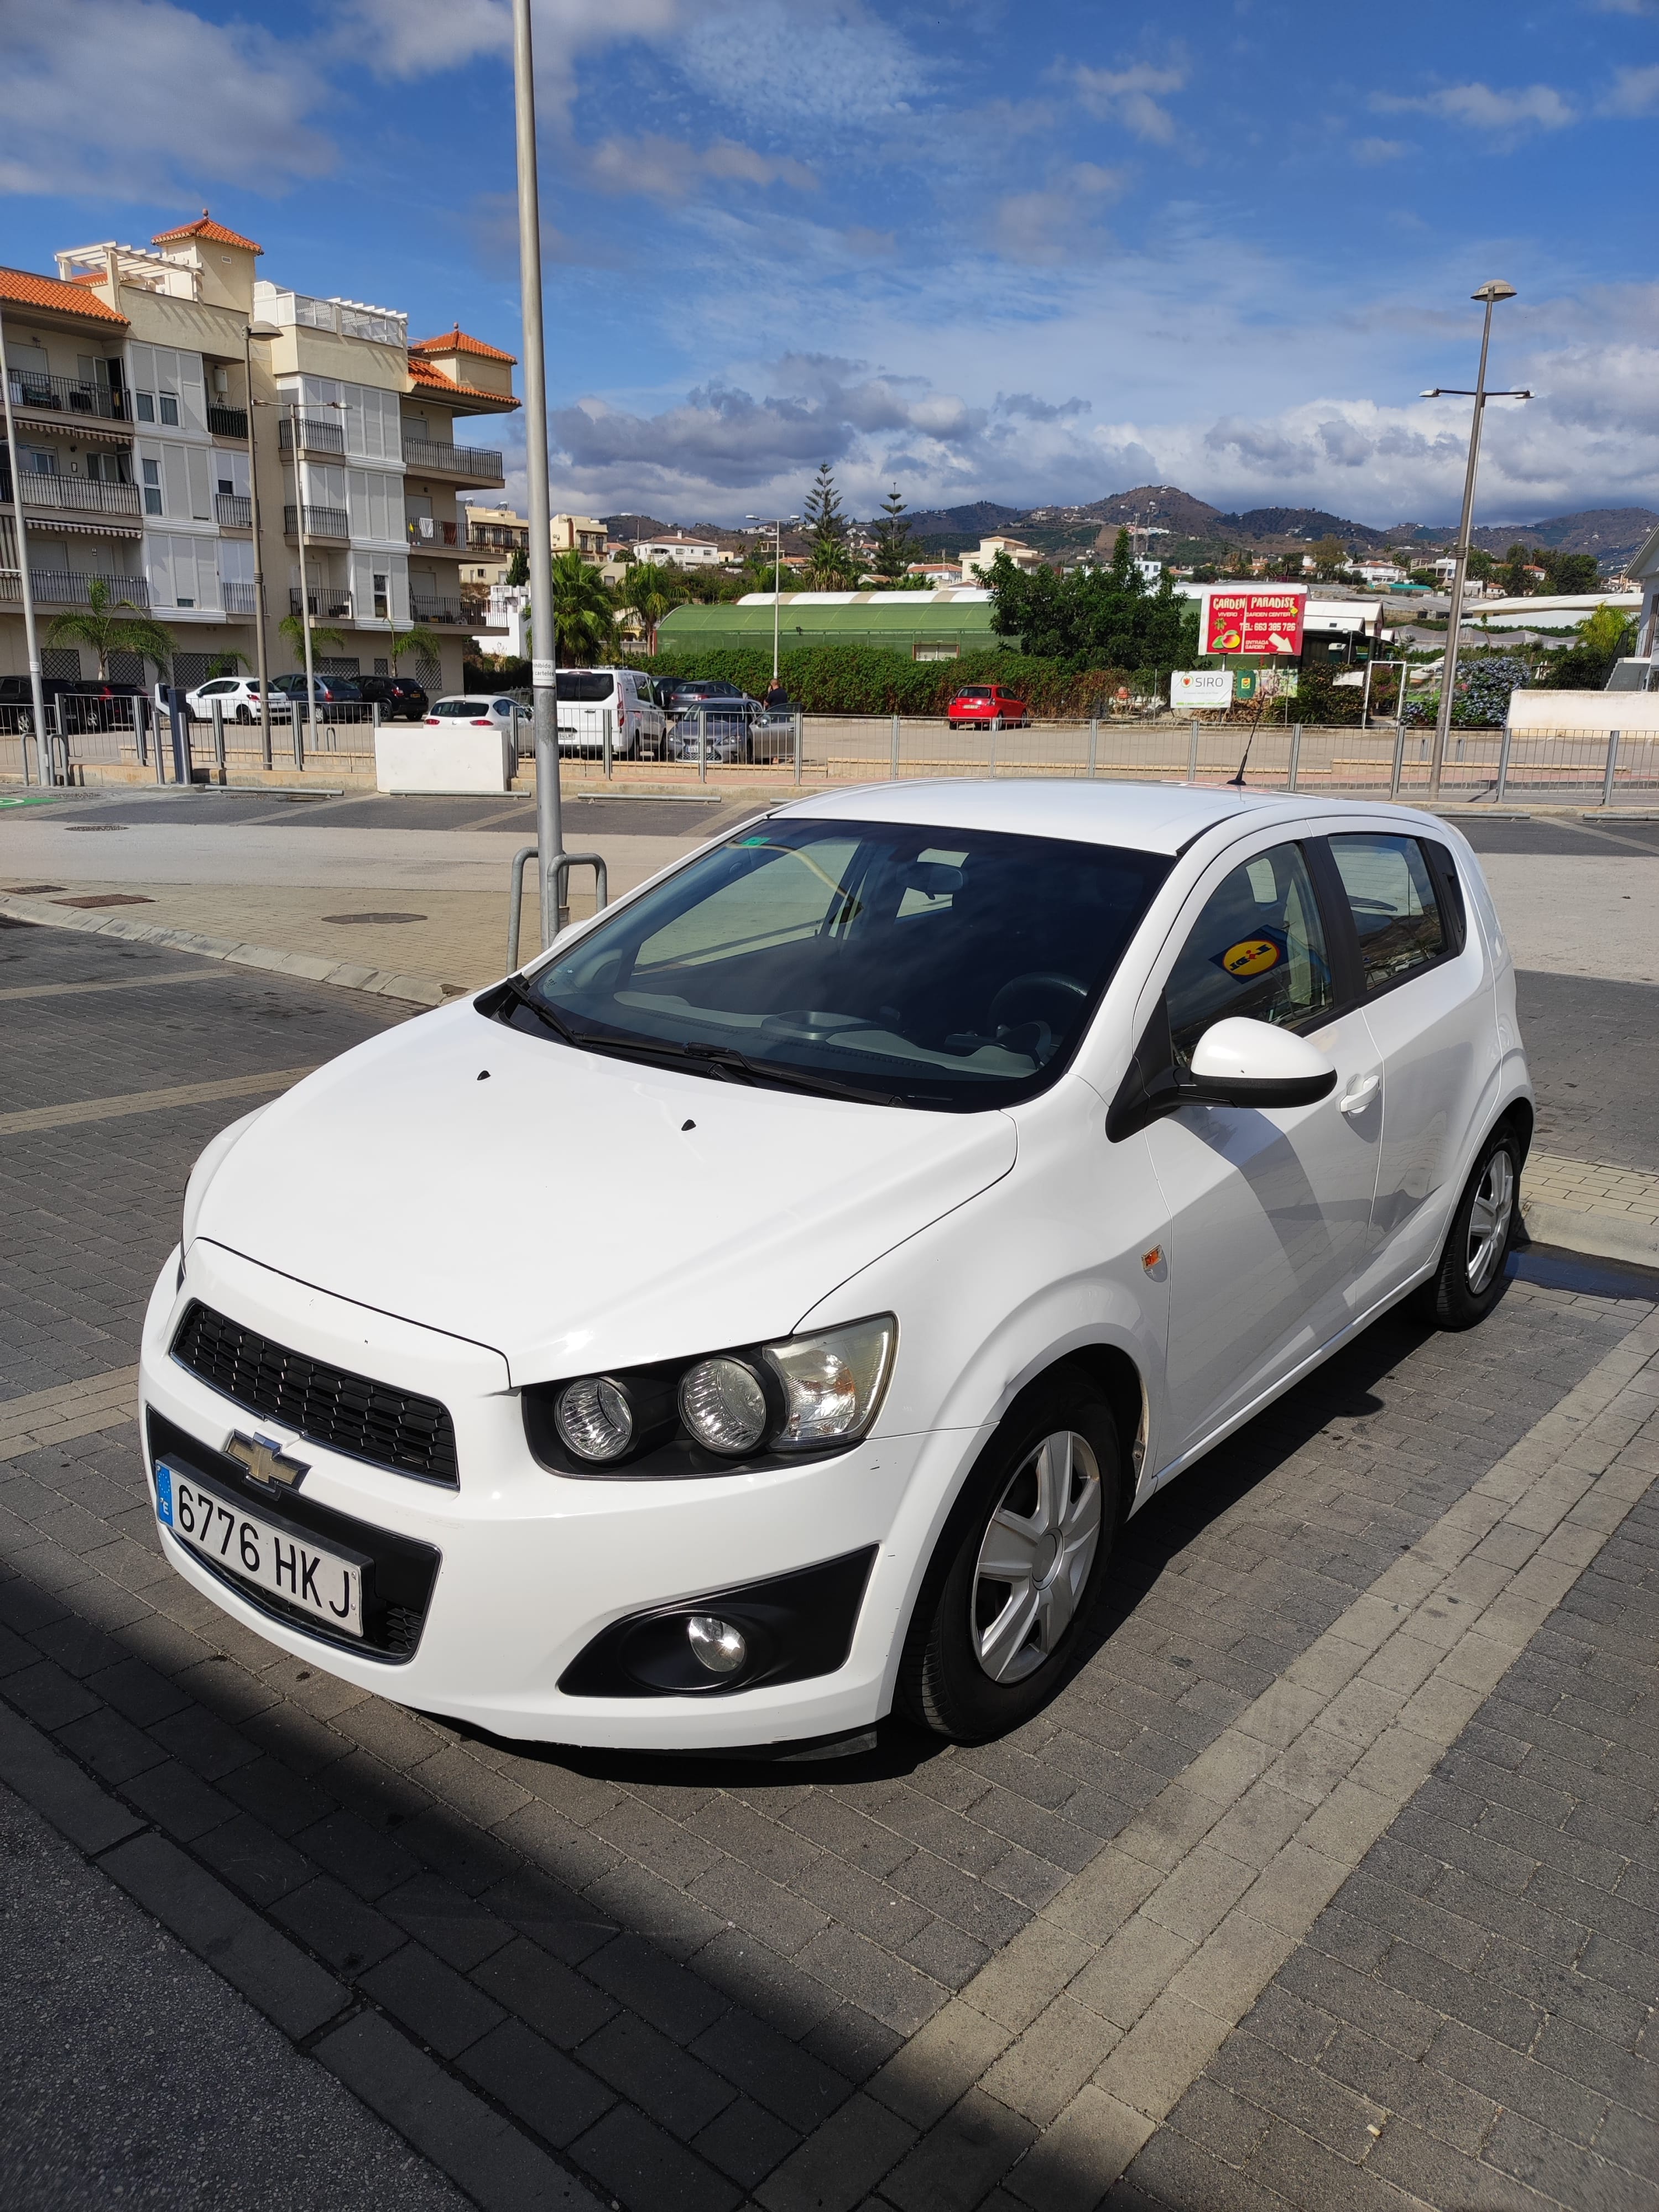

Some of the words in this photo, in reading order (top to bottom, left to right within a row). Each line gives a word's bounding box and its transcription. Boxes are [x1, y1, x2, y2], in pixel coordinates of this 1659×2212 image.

[1213, 598, 1246, 611] GARDEN
[1254, 623, 1267, 631] 663
[1268, 623, 1281, 631] 385
[1282, 623, 1296, 631] 726
[1195, 677, 1223, 687] SIRO
[163, 1501, 169, 1516] E
[179, 1484, 260, 1572] 6776
[274, 1536, 349, 1618] HKJ
